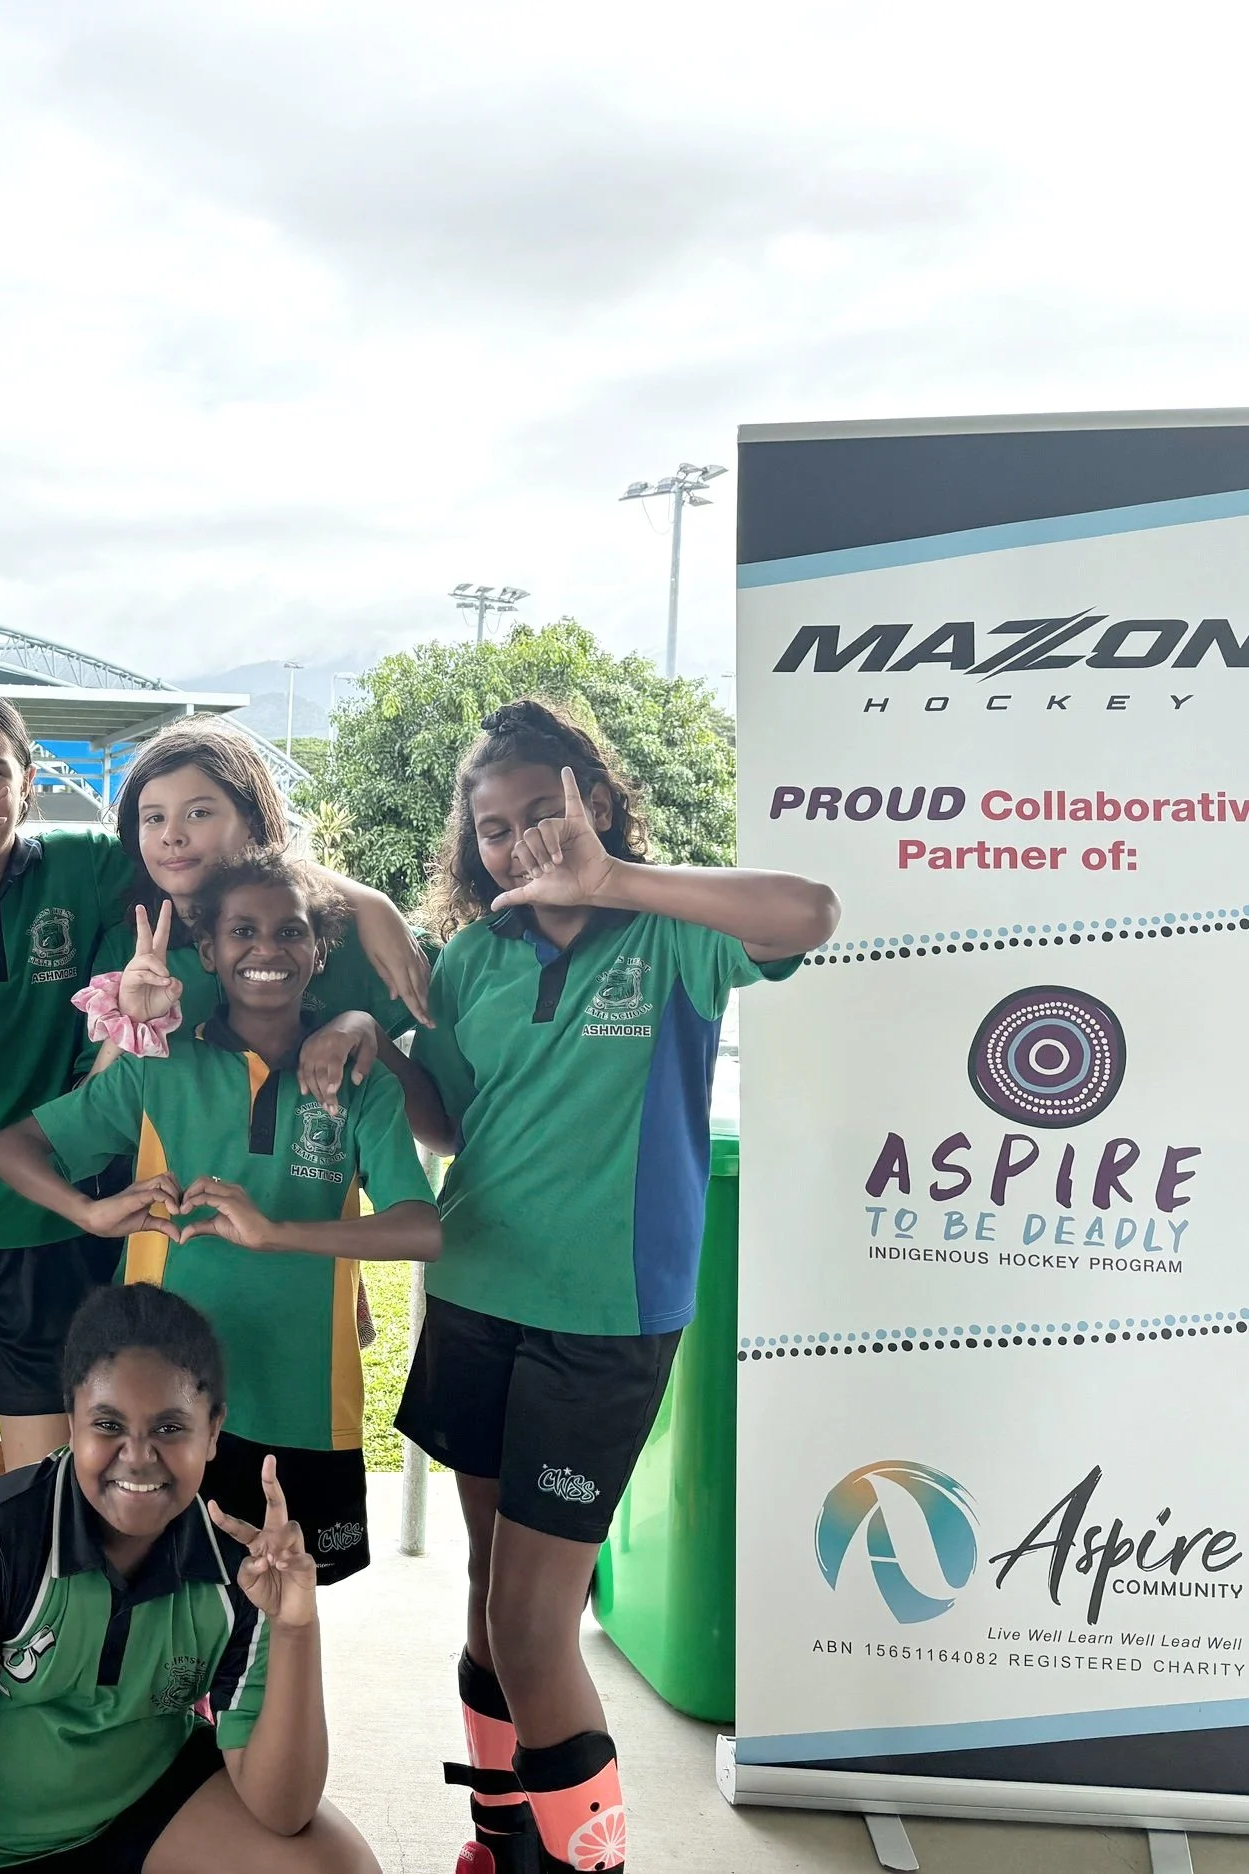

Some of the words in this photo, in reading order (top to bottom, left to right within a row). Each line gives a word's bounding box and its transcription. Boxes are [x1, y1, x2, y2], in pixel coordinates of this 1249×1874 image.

[772, 608, 1249, 681] MAZON
[864, 695, 1193, 712] HOCKEY
[770, 786, 965, 821] PROUD
[899, 840, 1066, 869] Partner
[1082, 841, 1136, 870] of:
[610, 1003, 653, 1021] SCHOOL
[582, 1024, 651, 1037] ASHMORE
[865, 1132, 1201, 1212] ASPIRE
[865, 1206, 917, 1239] TO
[944, 1211, 996, 1241] BE
[1023, 1214, 1188, 1253] DEADLY
[870, 1246, 988, 1264] INDIGENOUS
[1000, 1253, 1079, 1268] HOCKEY
[1090, 1258, 1181, 1273] PROGRAM
[989, 1465, 1242, 1625] Aspire
[1113, 1579, 1242, 1598] COMMUNITY
[988, 1627, 1020, 1640] Live
[1029, 1629, 1062, 1642] Well
[1068, 1631, 1112, 1644] Learn
[1122, 1633, 1154, 1646] Well
[1161, 1635, 1201, 1648] Lead
[1208, 1637, 1242, 1650] Well
[813, 1640, 851, 1654] ABN
[865, 1644, 997, 1665] 15651164082
[1010, 1654, 1141, 1671] REGISTERED
[1154, 1660, 1244, 1676] CHARITY
